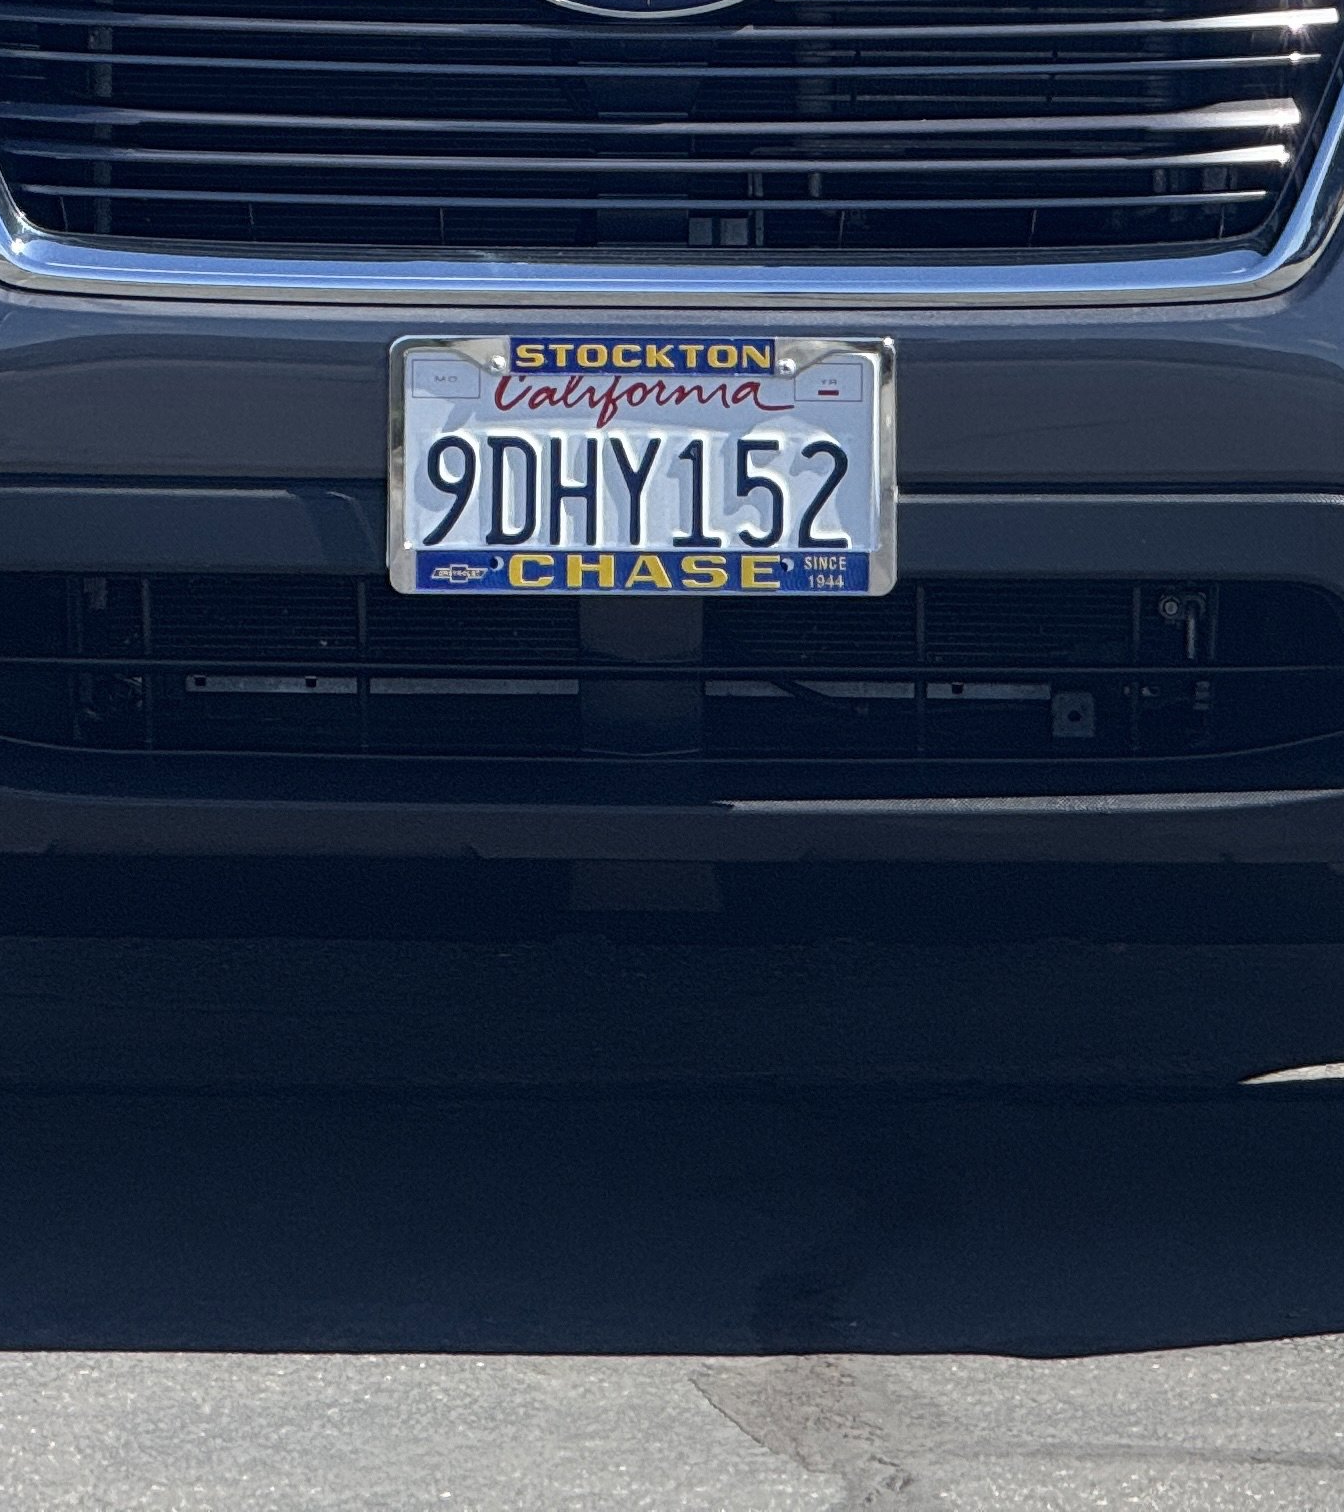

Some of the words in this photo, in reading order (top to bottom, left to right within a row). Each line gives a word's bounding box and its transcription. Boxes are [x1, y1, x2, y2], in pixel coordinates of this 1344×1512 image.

[514, 343, 771, 370] STOCKTON
[494, 373, 796, 429] California
[421, 435, 850, 549] 9DHY152
[508, 553, 782, 589] CHASE
[803, 556, 847, 571] SINCE
[808, 574, 845, 589] 1944
